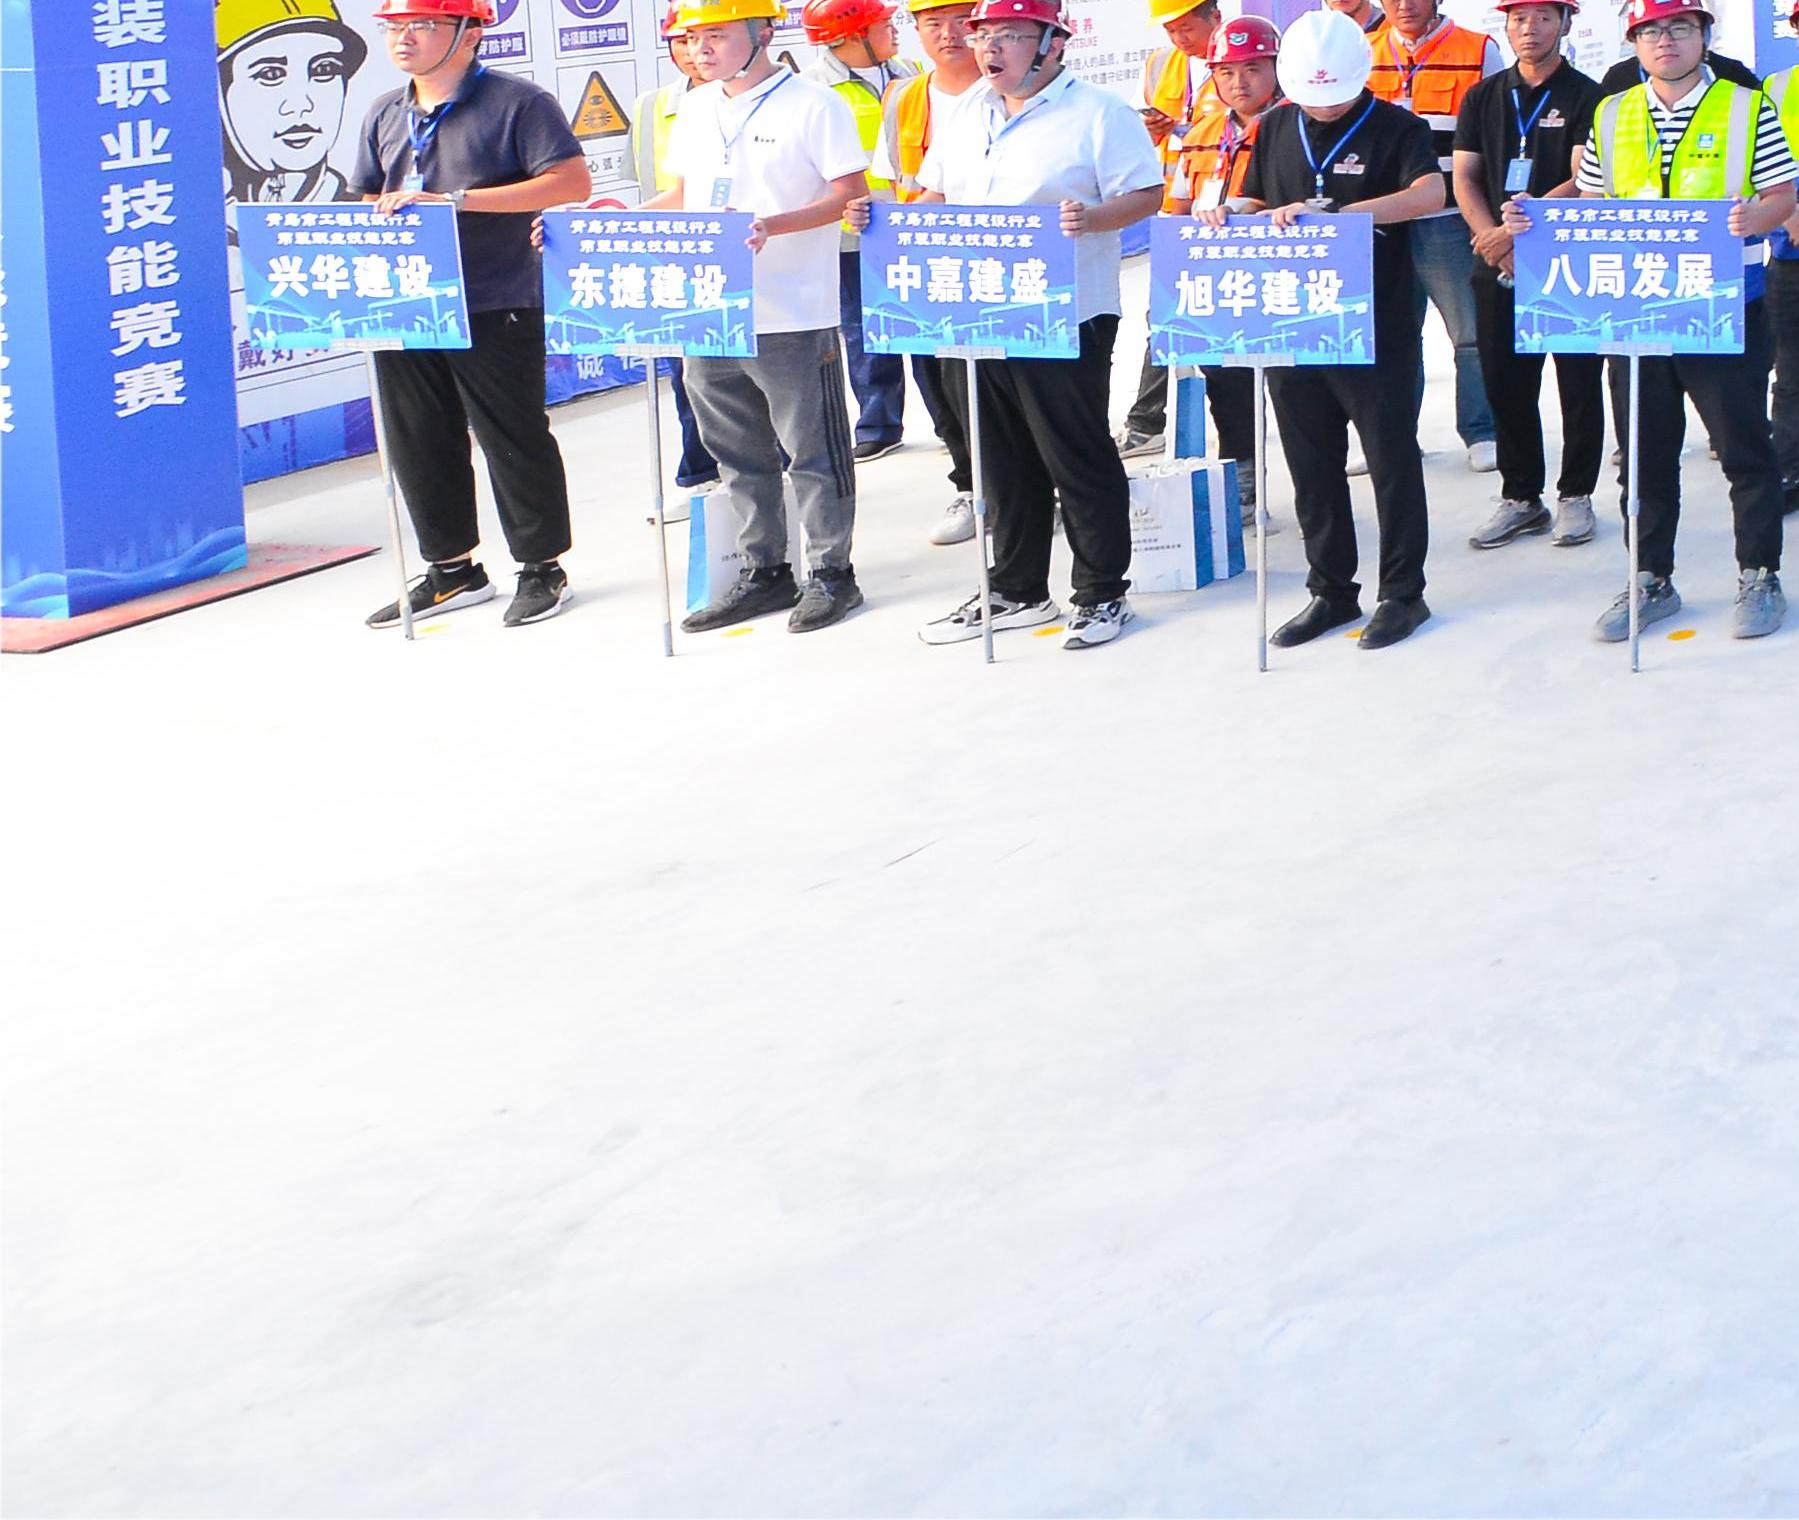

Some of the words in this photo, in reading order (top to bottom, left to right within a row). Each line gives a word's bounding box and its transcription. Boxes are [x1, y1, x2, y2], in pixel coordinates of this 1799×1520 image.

[266, 213, 422, 228] 青岛市工程建设行业
[571, 220, 722, 236] 青岛市工程建设行业
[888, 213, 1041, 229] 青岛市工程建设行业
[1544, 208, 1707, 223] 青岛市工程建设行业
[1180, 225, 1338, 241] 青岛市工程建设行业
[268, 255, 434, 297] 兴华建设
[569, 266, 727, 309] 东捷建设
[888, 257, 1049, 303] 中嘉建盛
[1542, 253, 1715, 297] 八局发展
[1176, 269, 1344, 316] 旭华建设
